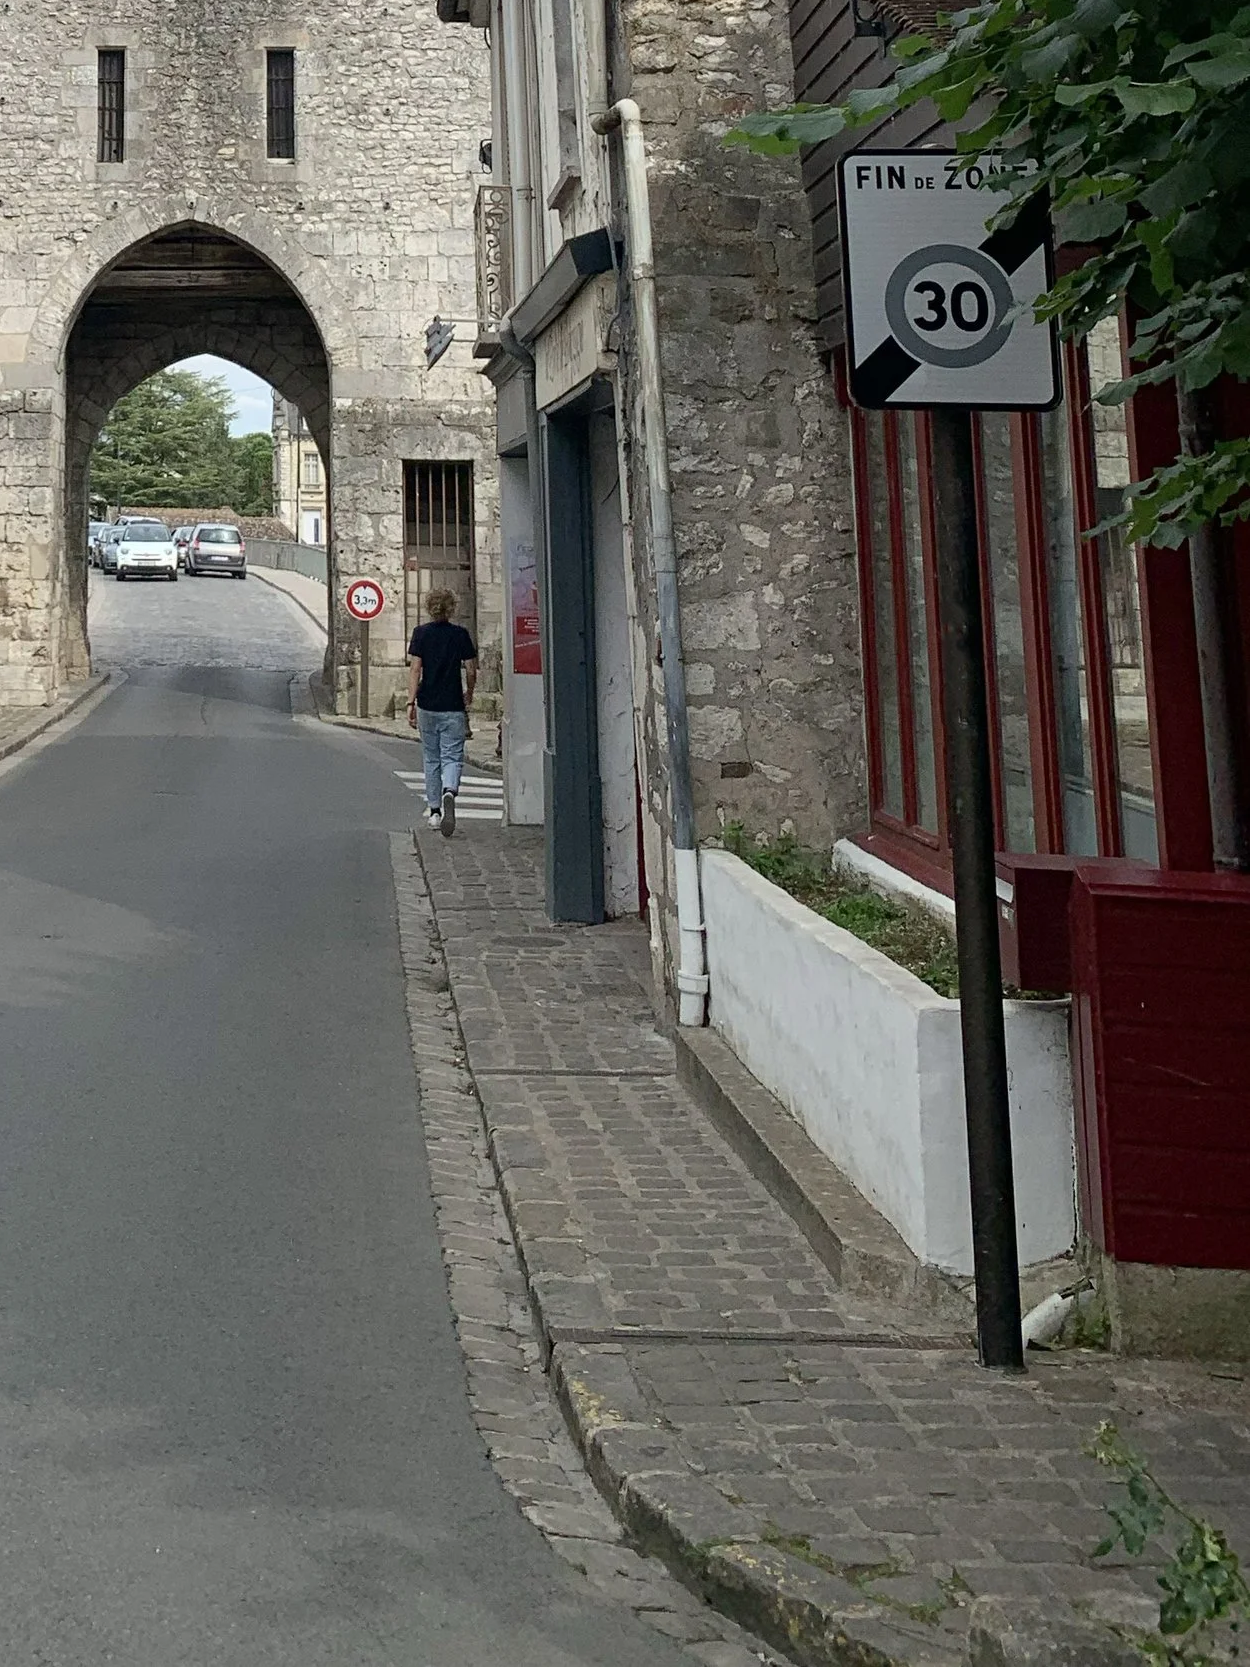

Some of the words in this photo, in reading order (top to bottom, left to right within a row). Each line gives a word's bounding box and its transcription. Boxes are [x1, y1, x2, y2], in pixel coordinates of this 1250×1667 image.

[856, 165, 906, 190] FIN
[915, 177, 935, 190] DE
[913, 281, 989, 332] 30
